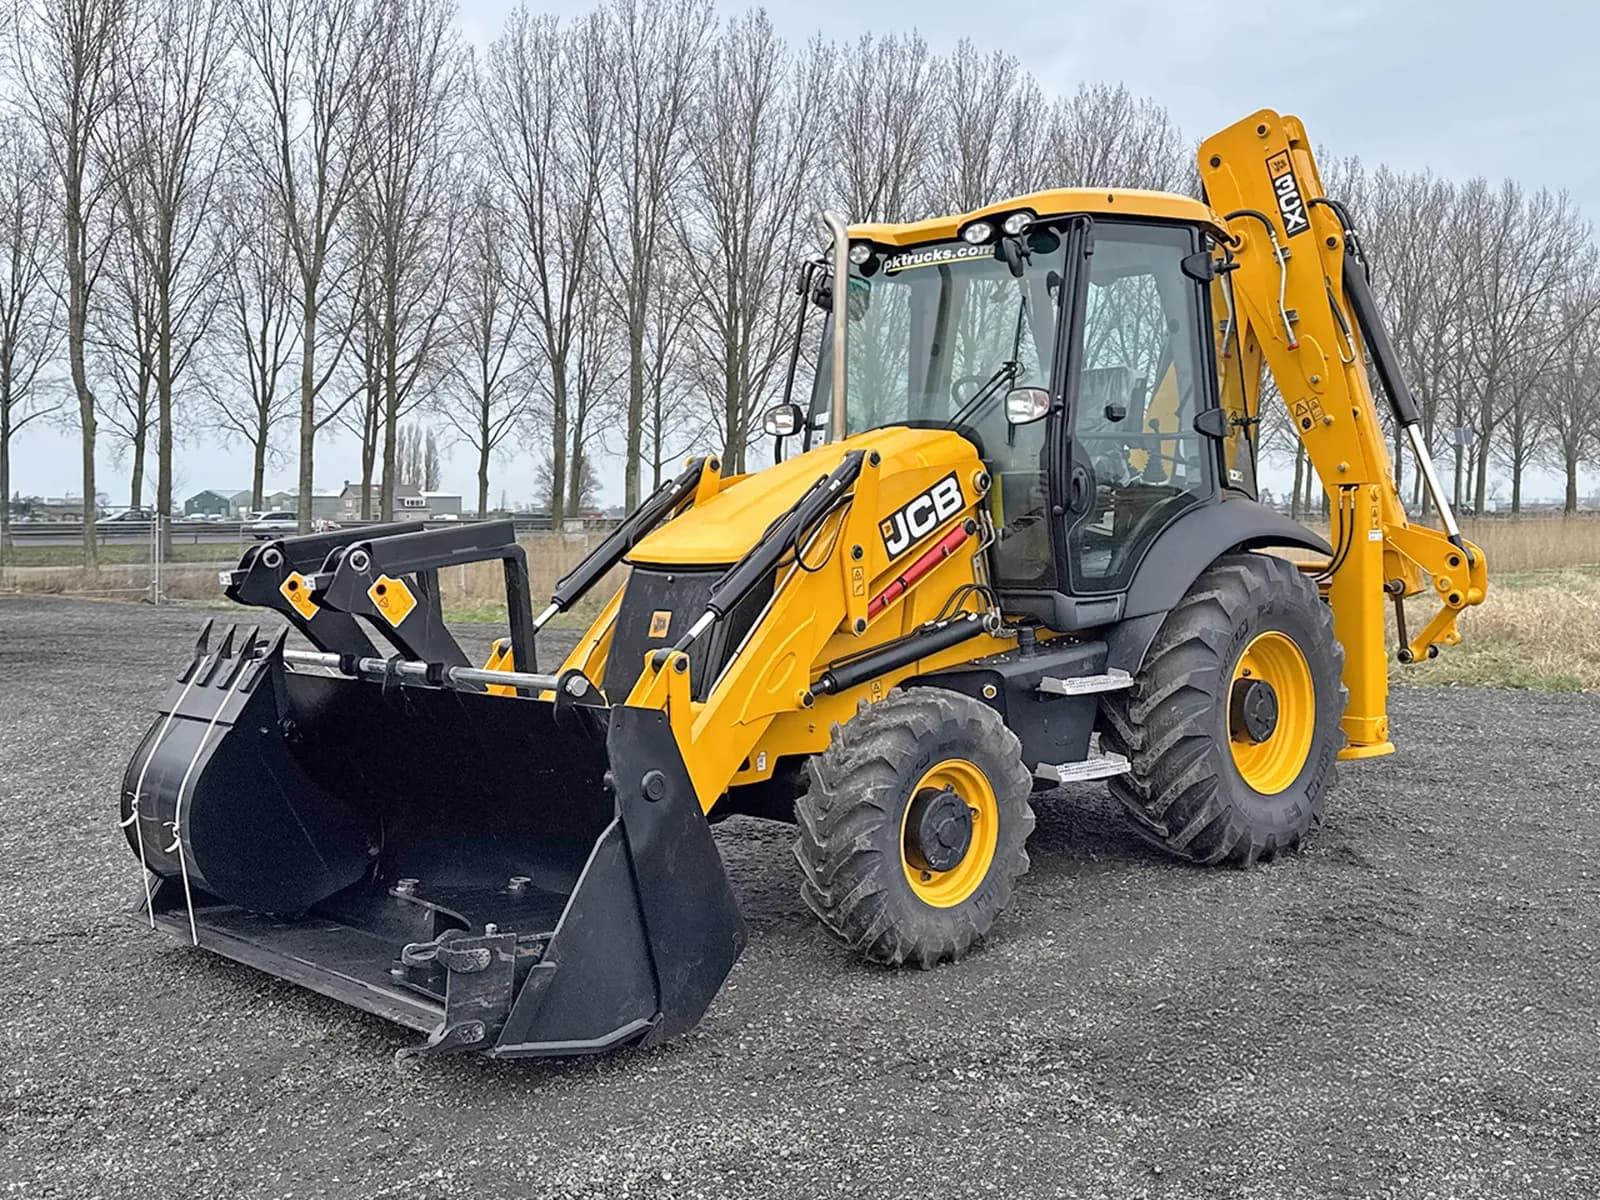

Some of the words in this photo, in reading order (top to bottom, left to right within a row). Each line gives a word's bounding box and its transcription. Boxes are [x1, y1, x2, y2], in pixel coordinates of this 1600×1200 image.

[1274, 173, 1307, 231] 3CX
[883, 243, 996, 274] pktrucks.com
[886, 477, 963, 555] JCB
